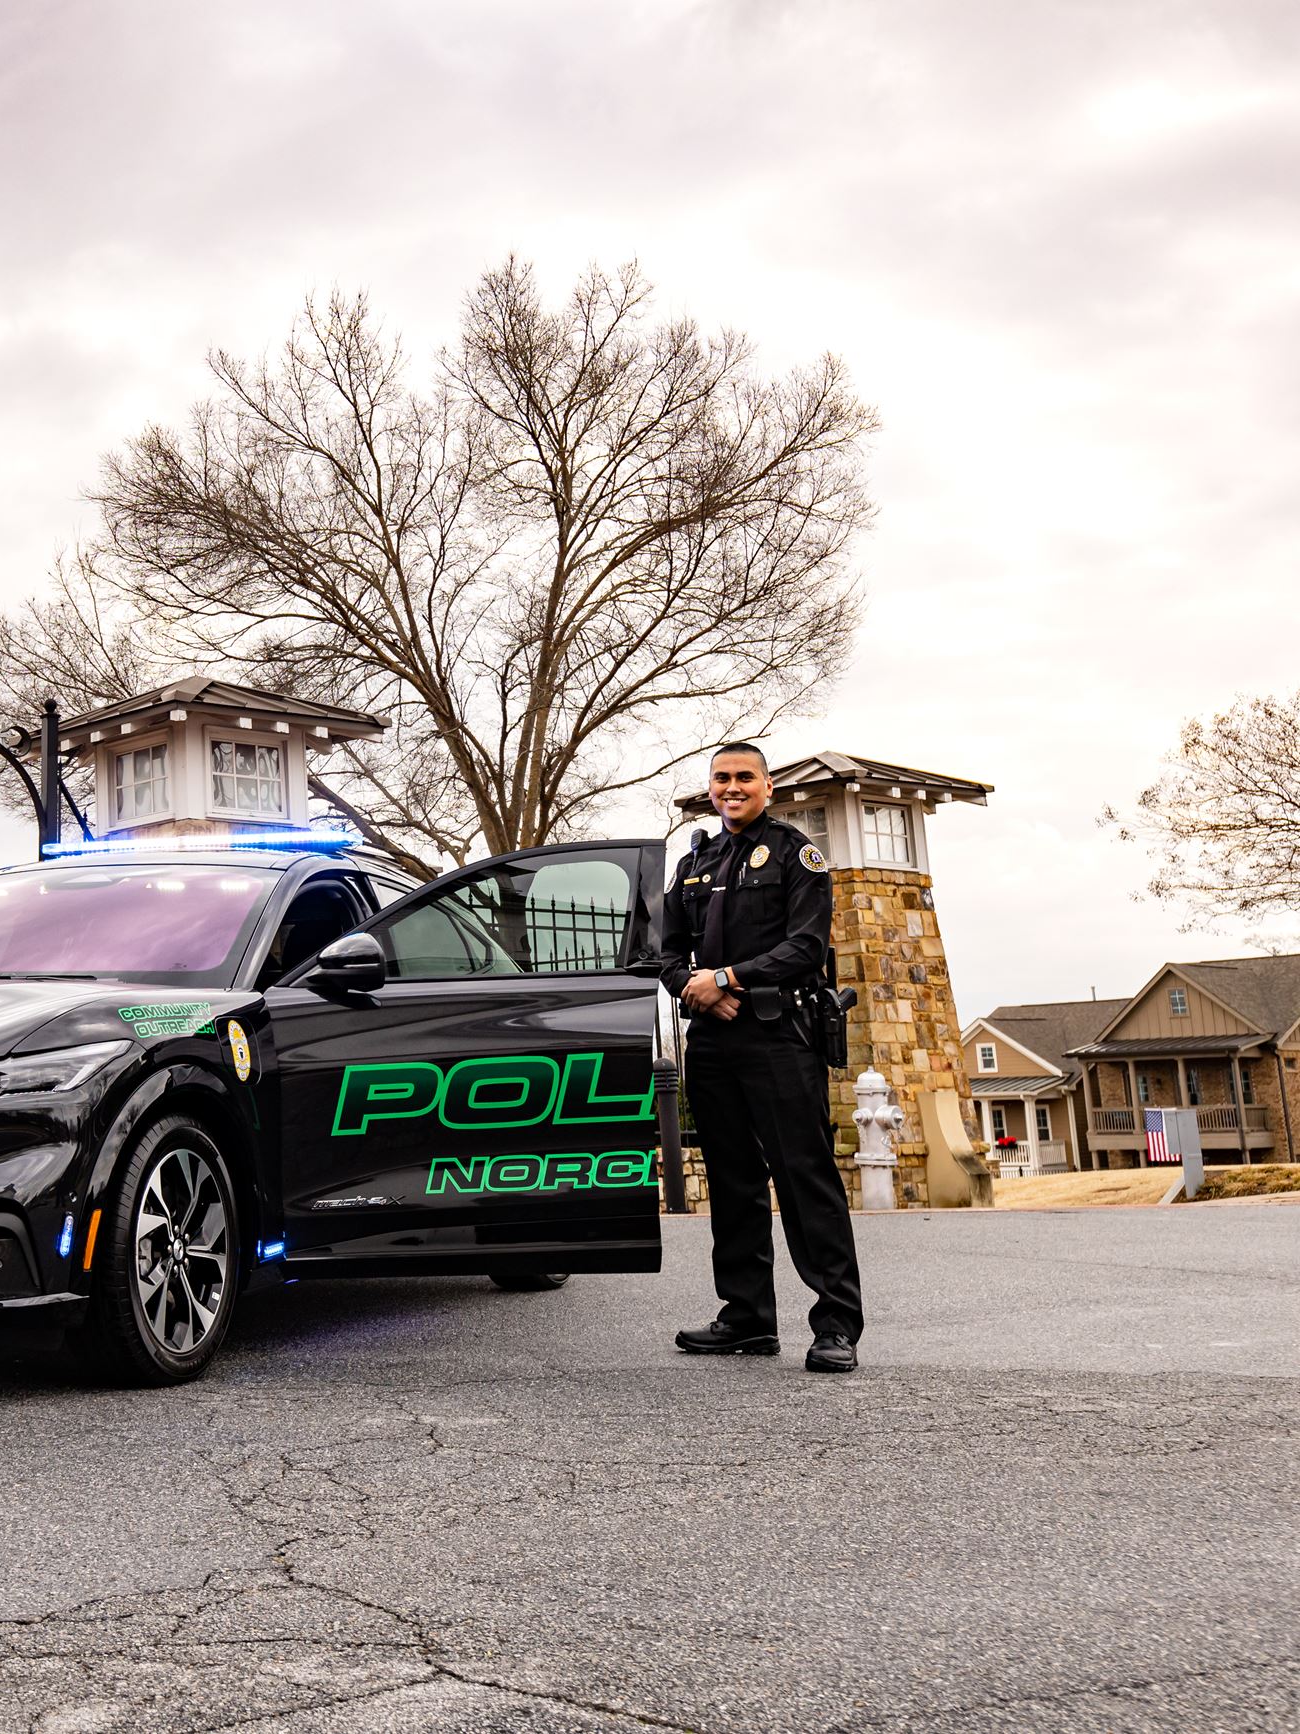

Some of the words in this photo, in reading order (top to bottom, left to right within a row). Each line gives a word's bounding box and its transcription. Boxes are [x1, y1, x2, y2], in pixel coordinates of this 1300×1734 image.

[118, 1002, 211, 1022] COMMUNITY
[134, 1018, 216, 1039] OUTREACH
[331, 1053, 655, 1136] POL
[425, 1150, 660, 1194] NORC
